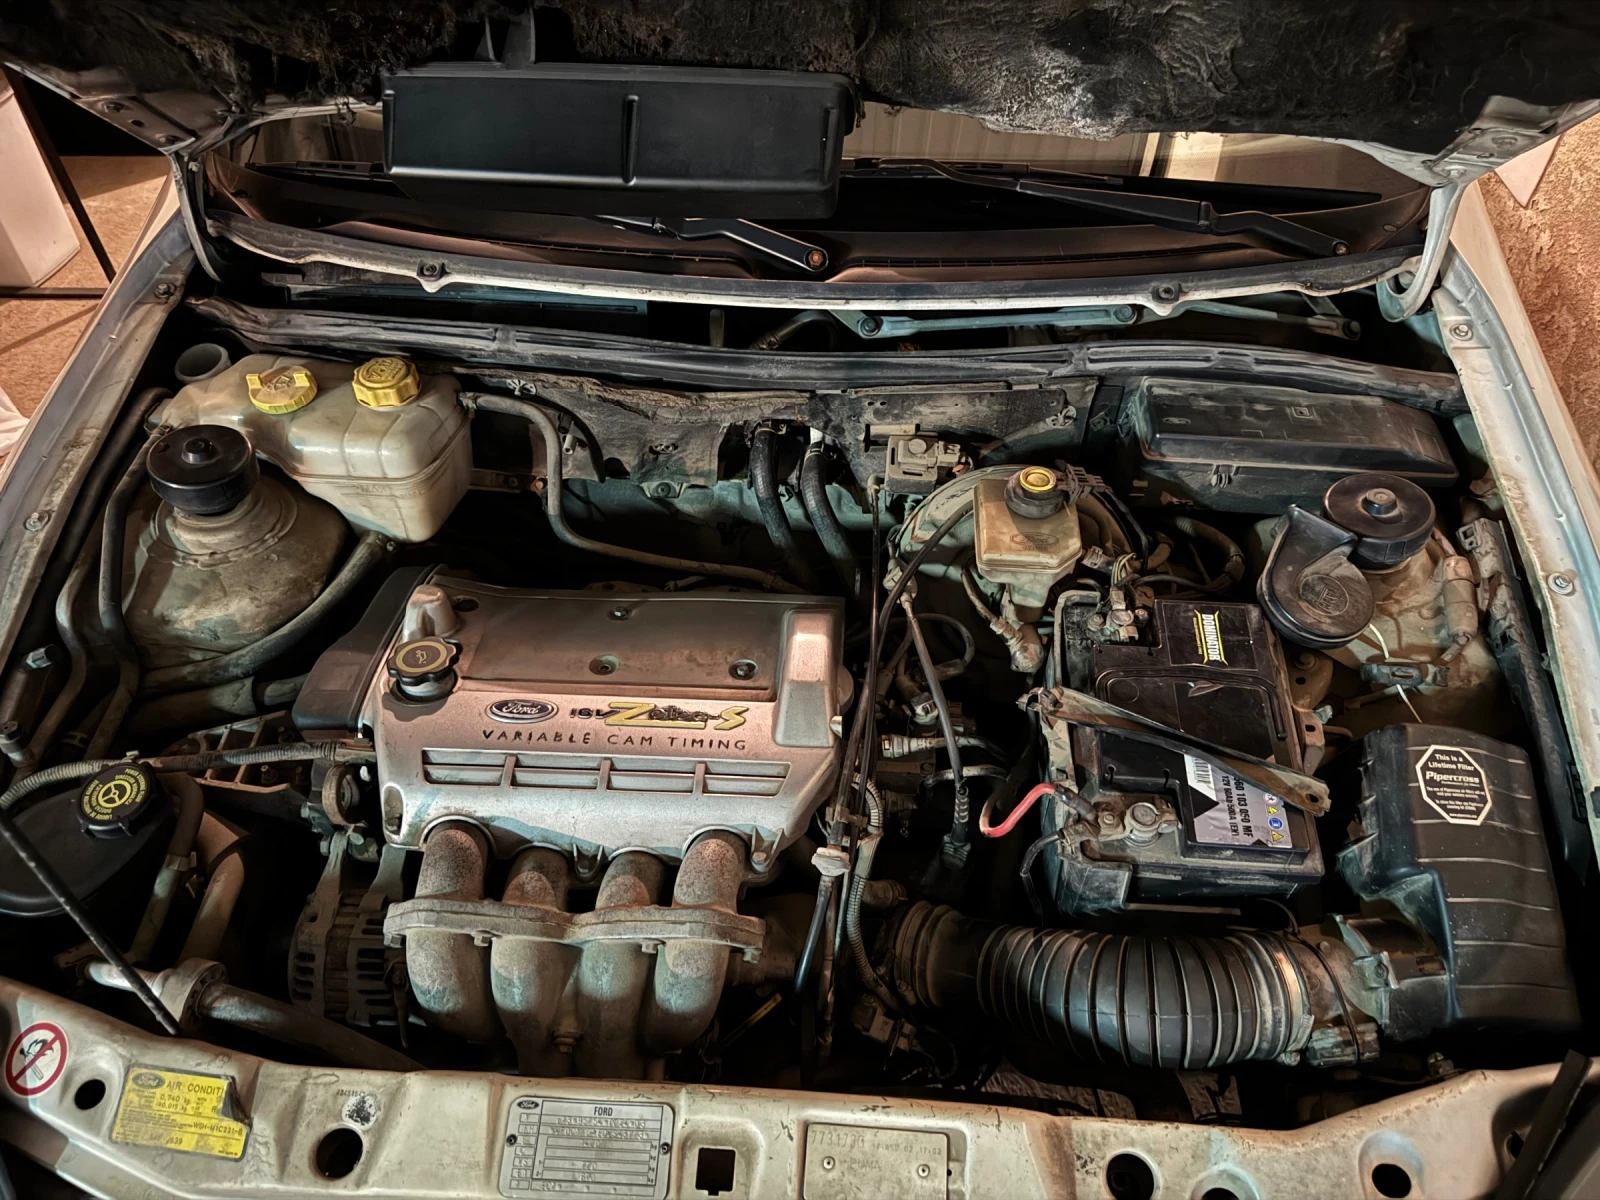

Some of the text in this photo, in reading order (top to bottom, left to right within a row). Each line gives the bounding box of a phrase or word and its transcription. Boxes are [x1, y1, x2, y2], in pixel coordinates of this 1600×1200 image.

[1201, 613, 1221, 660] DOMINATOR
[482, 729, 747, 750] VARIABLE CAM TIMING
[1428, 761, 1474, 771] Lifetime Filter
[1221, 775, 1231, 787] 12V
[1425, 771, 1480, 783] Pipercross
[1236, 793, 1248, 807] 103
[1242, 825, 1254, 838] MF
[166, 1080, 182, 1091] AIR
[160, 1093, 180, 1103] 0.740
[593, 1106, 614, 1117] FORD
